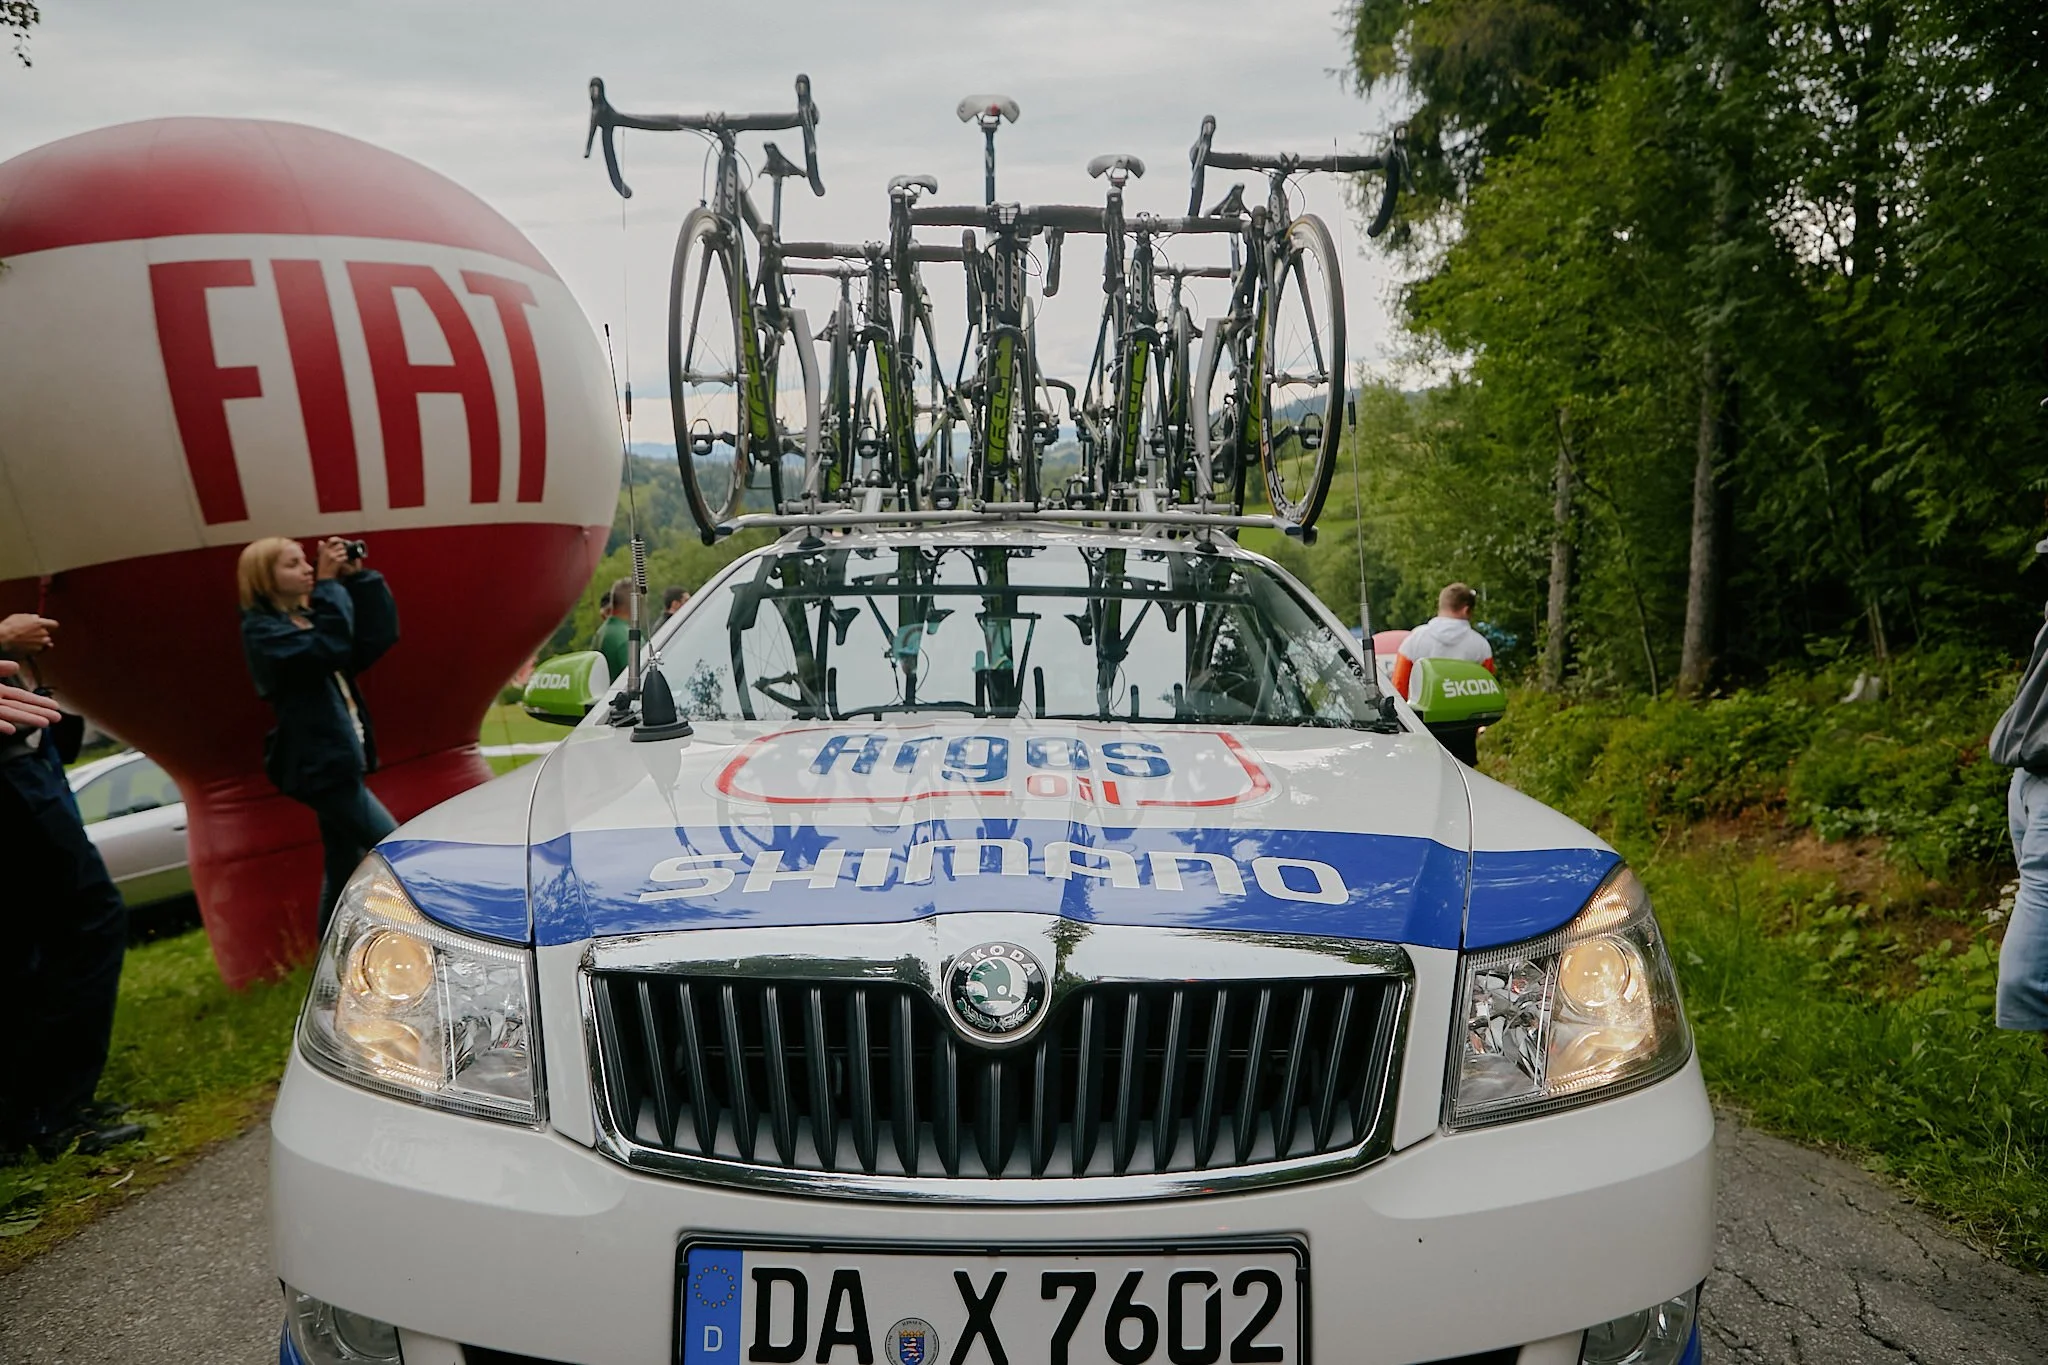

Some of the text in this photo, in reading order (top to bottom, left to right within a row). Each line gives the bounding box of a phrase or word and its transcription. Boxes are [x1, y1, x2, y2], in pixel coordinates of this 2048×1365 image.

[148, 258, 547, 525] FIAT
[1442, 678, 1500, 698] ŠKODA
[809, 734, 1172, 783] Argos
[1026, 774, 1121, 805] oil
[639, 837, 1350, 905] SHIMANO
[702, 1325, 723, 1352] D
[748, 1266, 1284, 1365] DA X 7602
